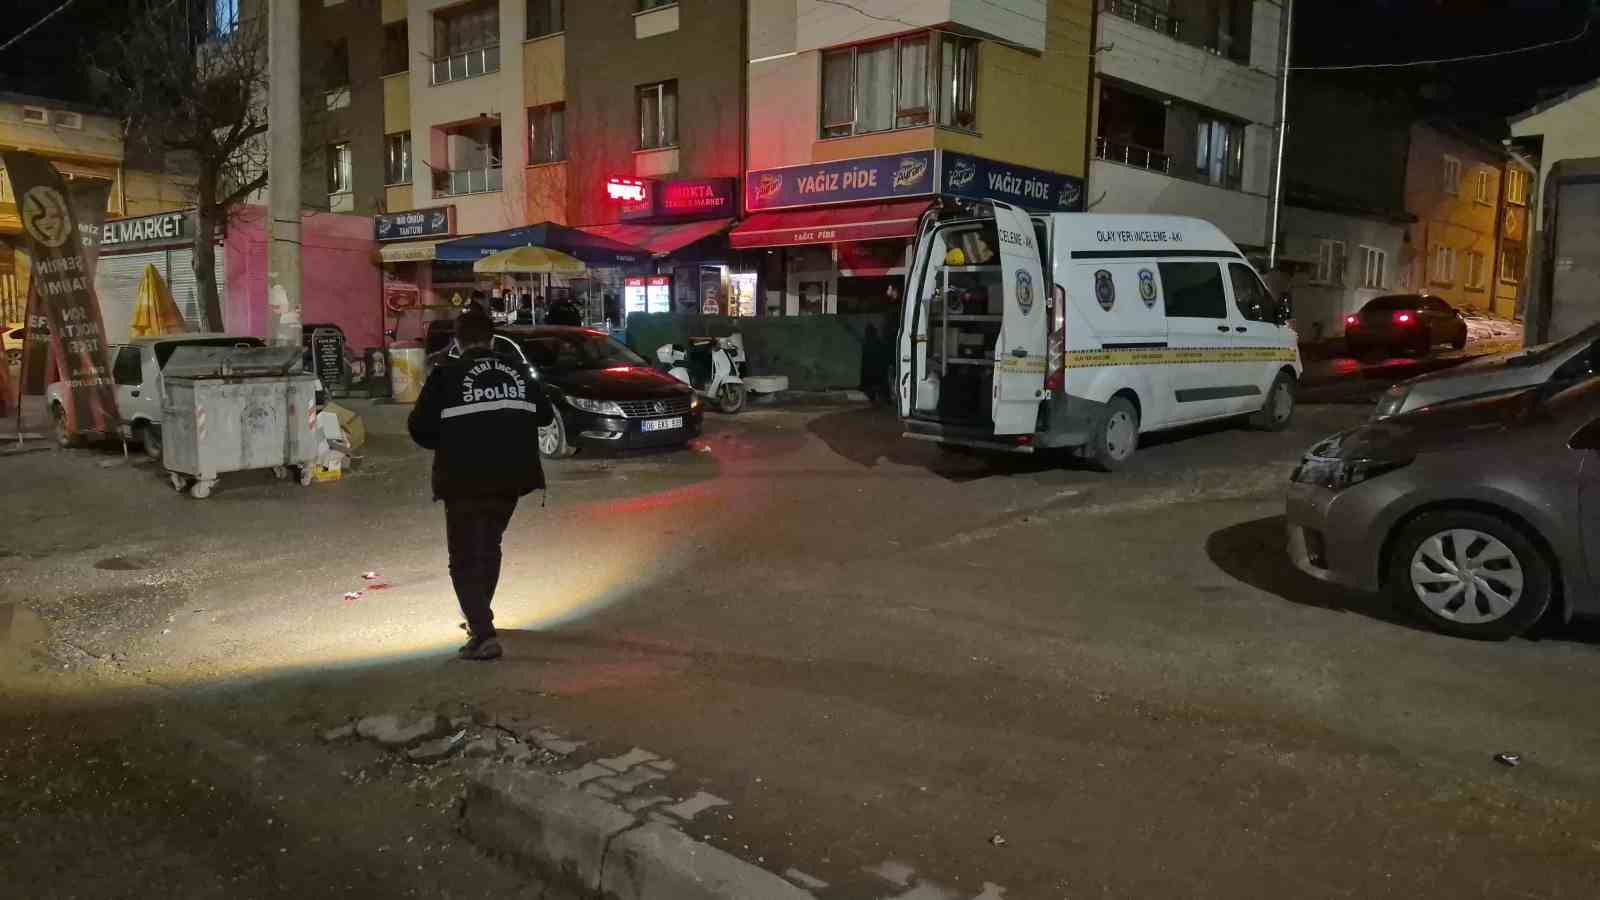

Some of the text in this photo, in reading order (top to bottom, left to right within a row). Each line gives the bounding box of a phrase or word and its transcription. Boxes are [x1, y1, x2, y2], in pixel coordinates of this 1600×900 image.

[797, 170, 839, 194] YAĞIZ
[843, 167, 878, 189] PİDE
[988, 171, 1021, 195] YAĞIZ
[1024, 177, 1050, 200] PİDE
[120, 214, 182, 242] MARKET
[474, 382, 518, 401] POLİS
